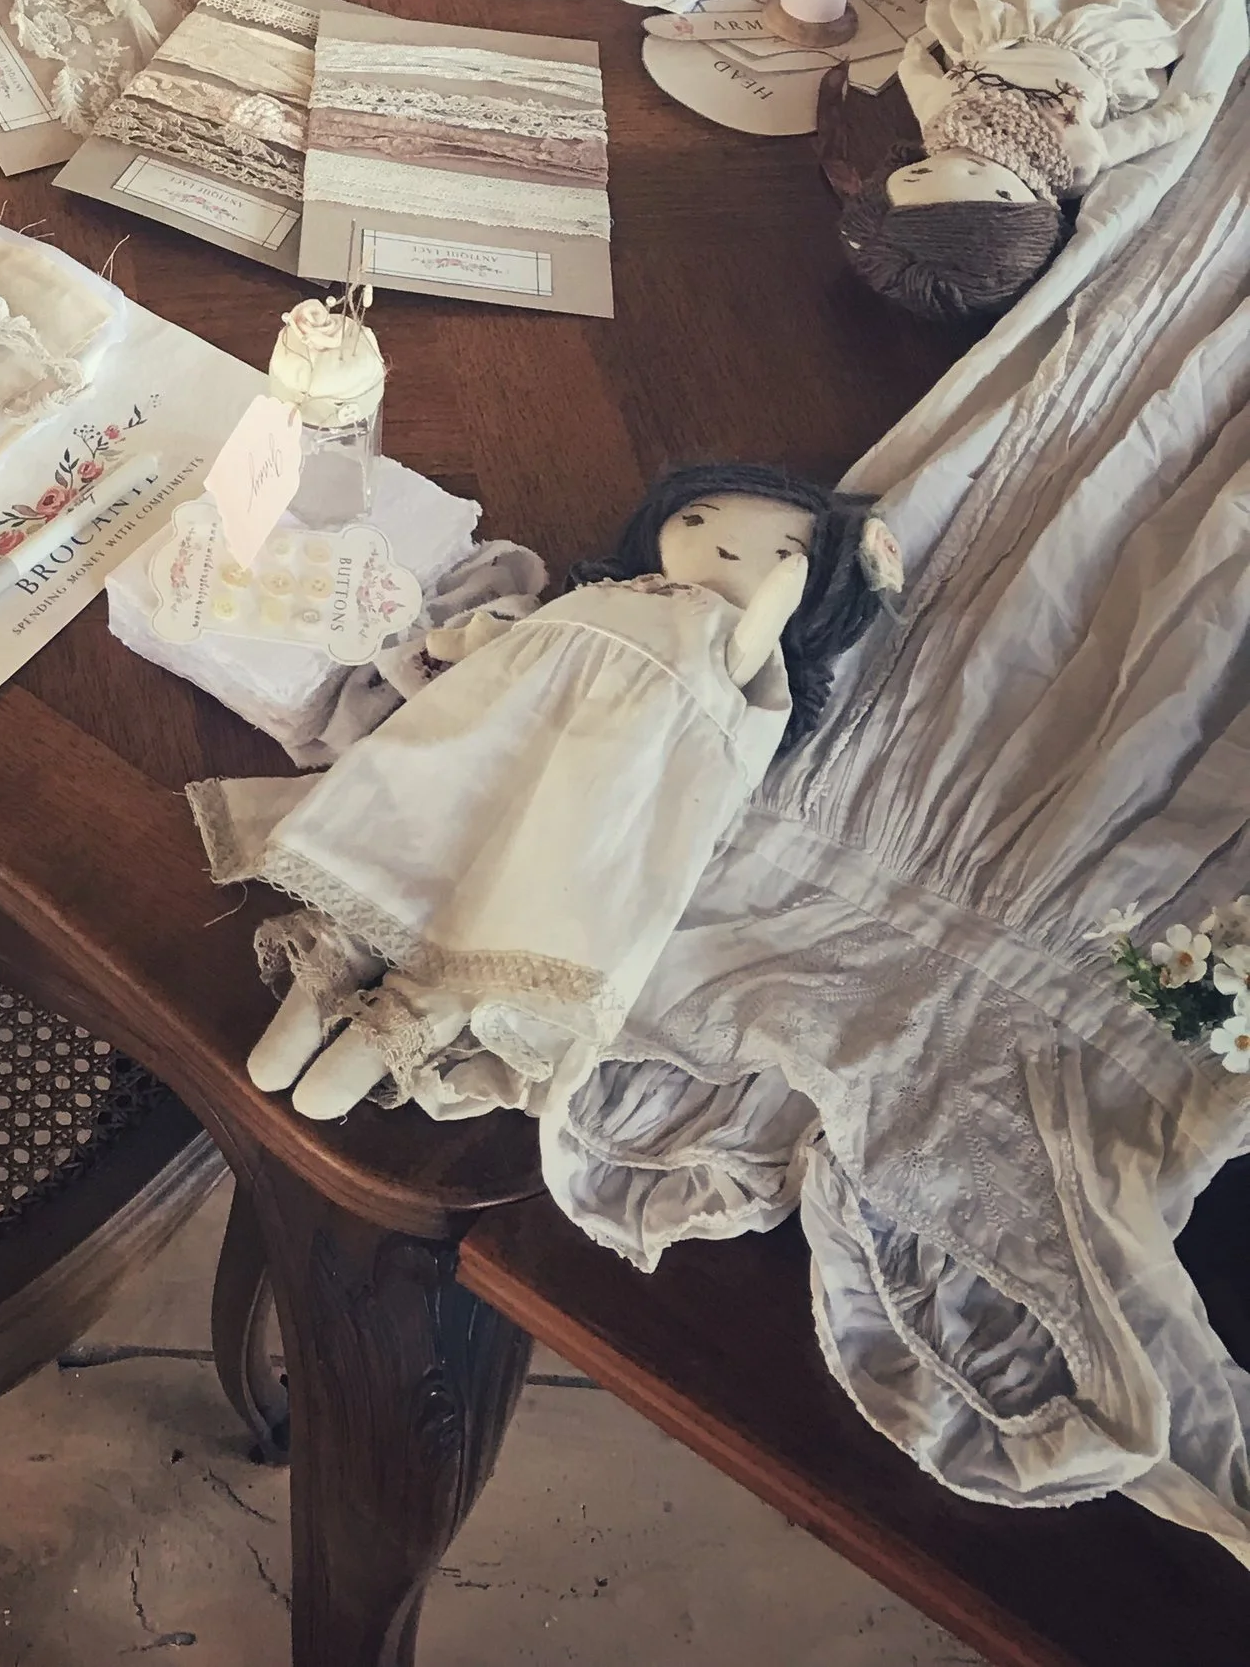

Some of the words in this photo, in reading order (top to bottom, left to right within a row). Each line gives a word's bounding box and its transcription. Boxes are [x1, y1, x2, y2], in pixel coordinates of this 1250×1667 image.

[713, 19, 764, 32] ARM
[714, 60, 774, 100] HEAD
[11, 586, 68, 636] SPENDING
[66, 549, 106, 585] MONEY
[105, 520, 136, 548] WITH
[135, 456, 205, 520] COMPLIMENTS
[330, 557, 353, 633] BUTTONS
